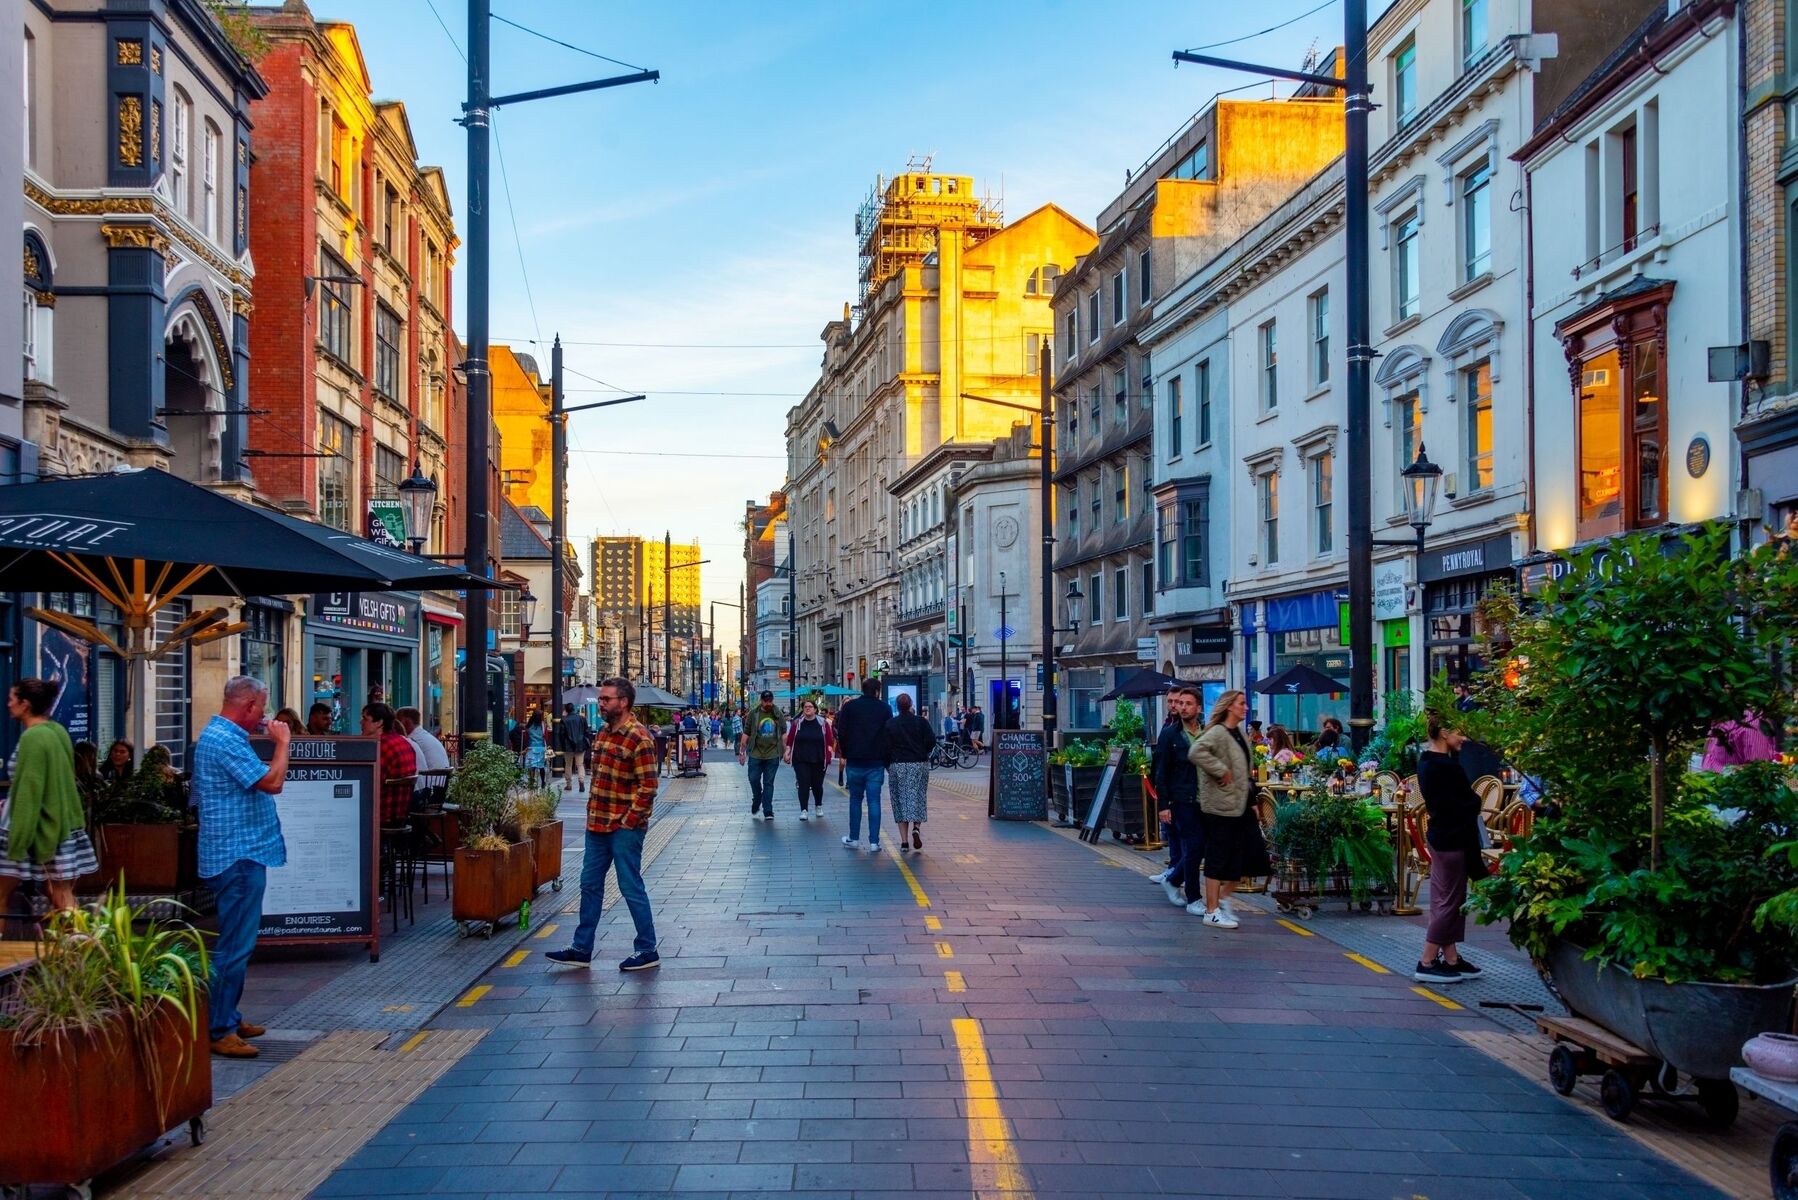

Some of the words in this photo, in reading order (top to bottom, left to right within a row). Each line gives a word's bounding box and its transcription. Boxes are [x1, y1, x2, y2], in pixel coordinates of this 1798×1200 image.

[0, 518, 128, 545] TURE
[1442, 549, 1483, 572] PENNYROYAL
[380, 602, 396, 622] GIFTS
[1177, 641, 1191, 656] WAR
[1001, 733, 1036, 741] CHANCE
[288, 742, 336, 758] PASTURE
[310, 769, 342, 781] MENU
